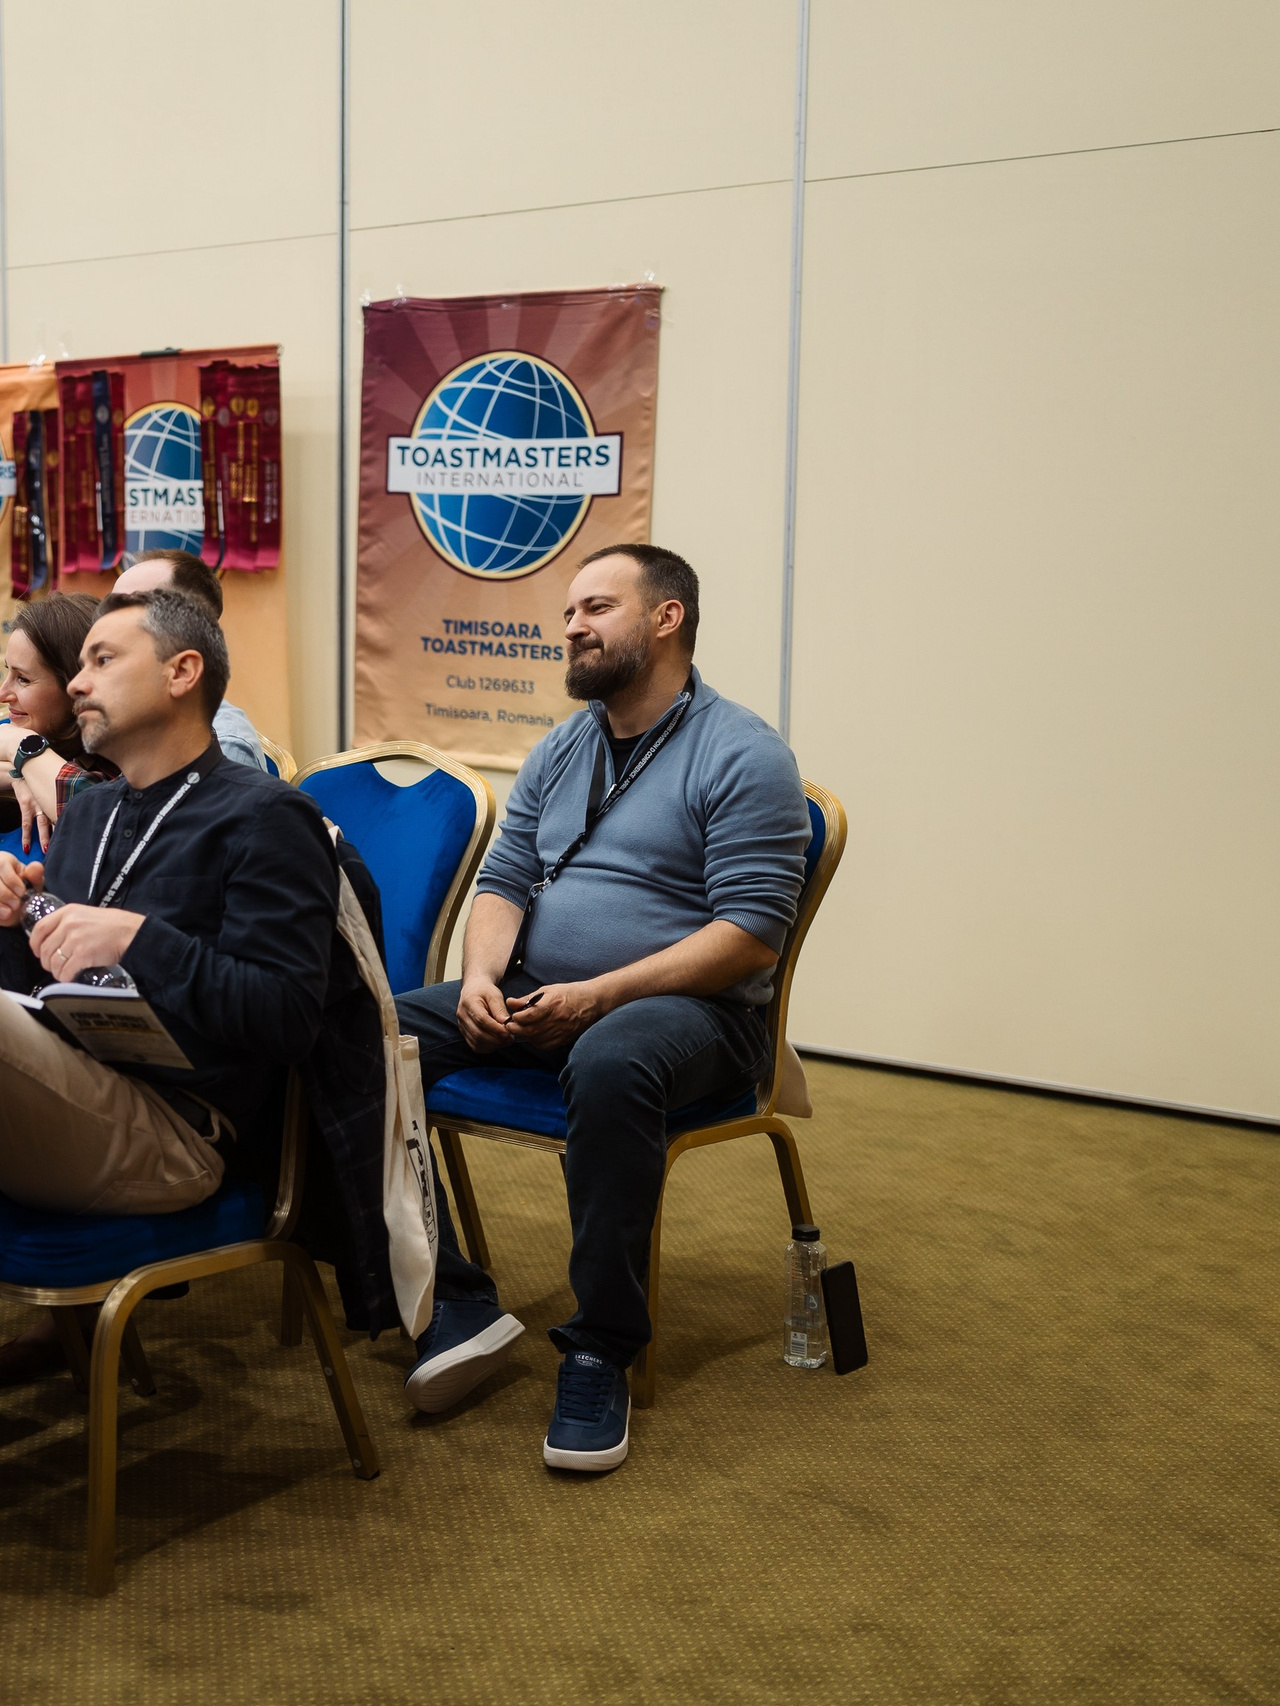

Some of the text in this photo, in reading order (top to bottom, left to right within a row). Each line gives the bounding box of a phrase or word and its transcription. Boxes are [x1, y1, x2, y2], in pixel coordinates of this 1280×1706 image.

[397, 445, 610, 468] TOASTMASTERS
[417, 471, 583, 488] INTERNATIONAL
[442, 619, 542, 639] TIMISOARA
[421, 636, 563, 661] TOASTMASTERS
[446, 675, 534, 694] Club 1269633
[425, 703, 554, 728] Timisoara, Romania
[629, 752, 652, 780] CONFERENCE
